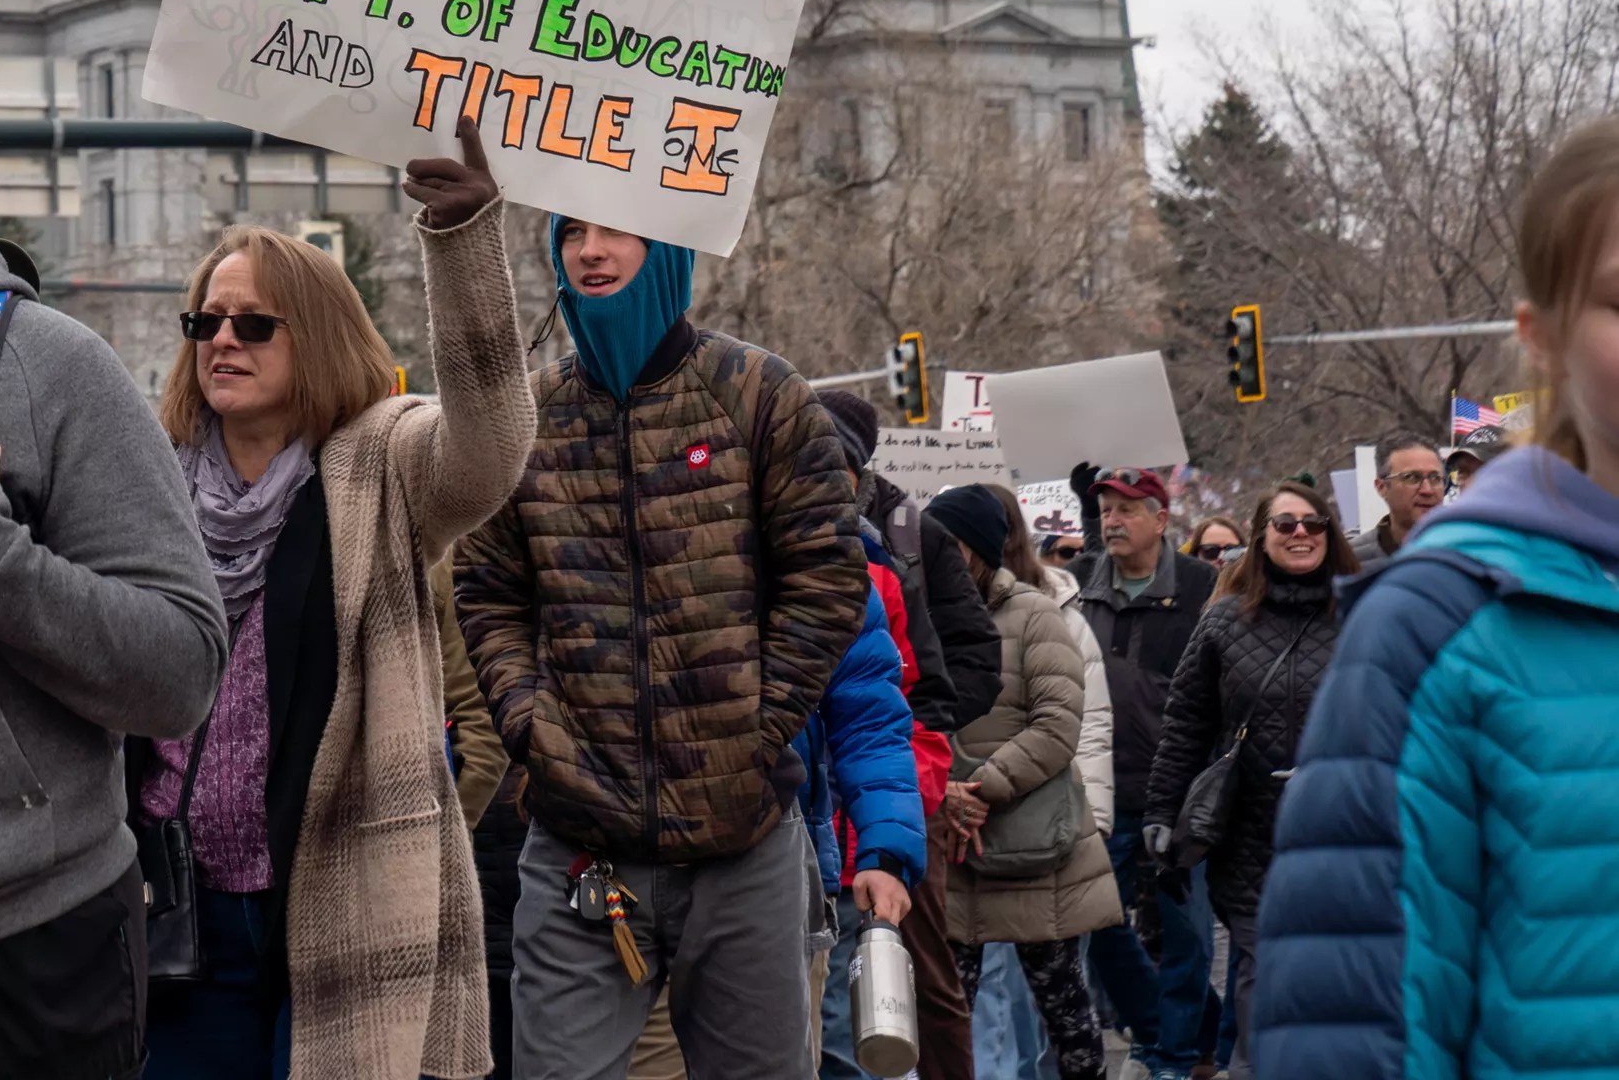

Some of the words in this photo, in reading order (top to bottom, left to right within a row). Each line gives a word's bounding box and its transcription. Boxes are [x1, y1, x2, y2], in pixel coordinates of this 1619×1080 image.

[252, 19, 374, 88] AND
[405, 48, 634, 173] TITLE
[660, 96, 742, 196] I
